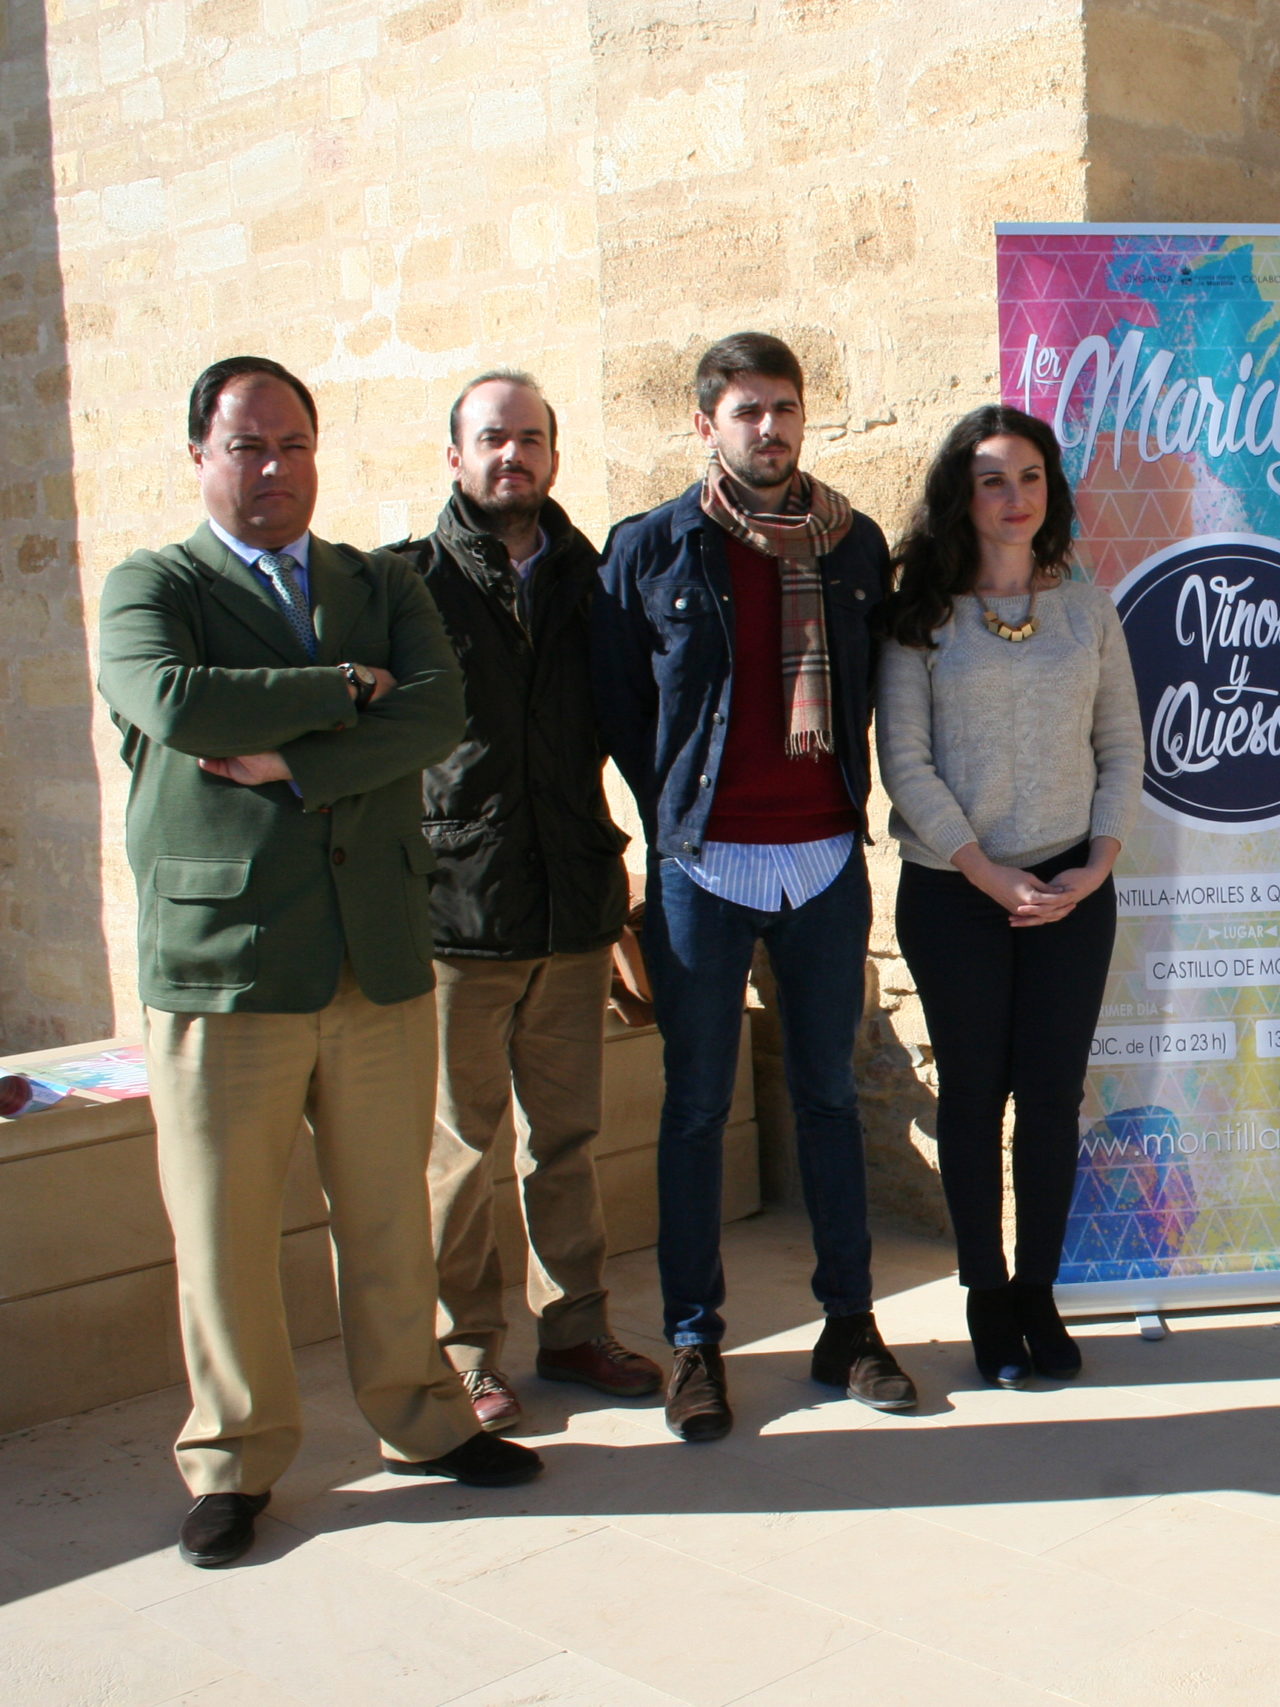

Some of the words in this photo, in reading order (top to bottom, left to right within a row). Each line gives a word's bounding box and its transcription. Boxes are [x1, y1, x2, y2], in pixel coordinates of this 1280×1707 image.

[1213, 654, 1279, 704] y
[1119, 886, 1244, 907] NTILLA-MORILES
[1251, 886, 1262, 902] &
[1223, 925, 1264, 939] LUGAR
[1152, 960, 1228, 980] CASTILLO
[1233, 959, 1255, 976] DE
[1099, 1003, 1134, 1017] RIMER
[1090, 1037, 1122, 1056] DIC.
[1126, 1038, 1144, 1053] de
[1149, 1034, 1171, 1056] (12
[1175, 1039, 1186, 1052] a
[1190, 1033, 1209, 1052] 23
[1212, 1031, 1227, 1053] h)
